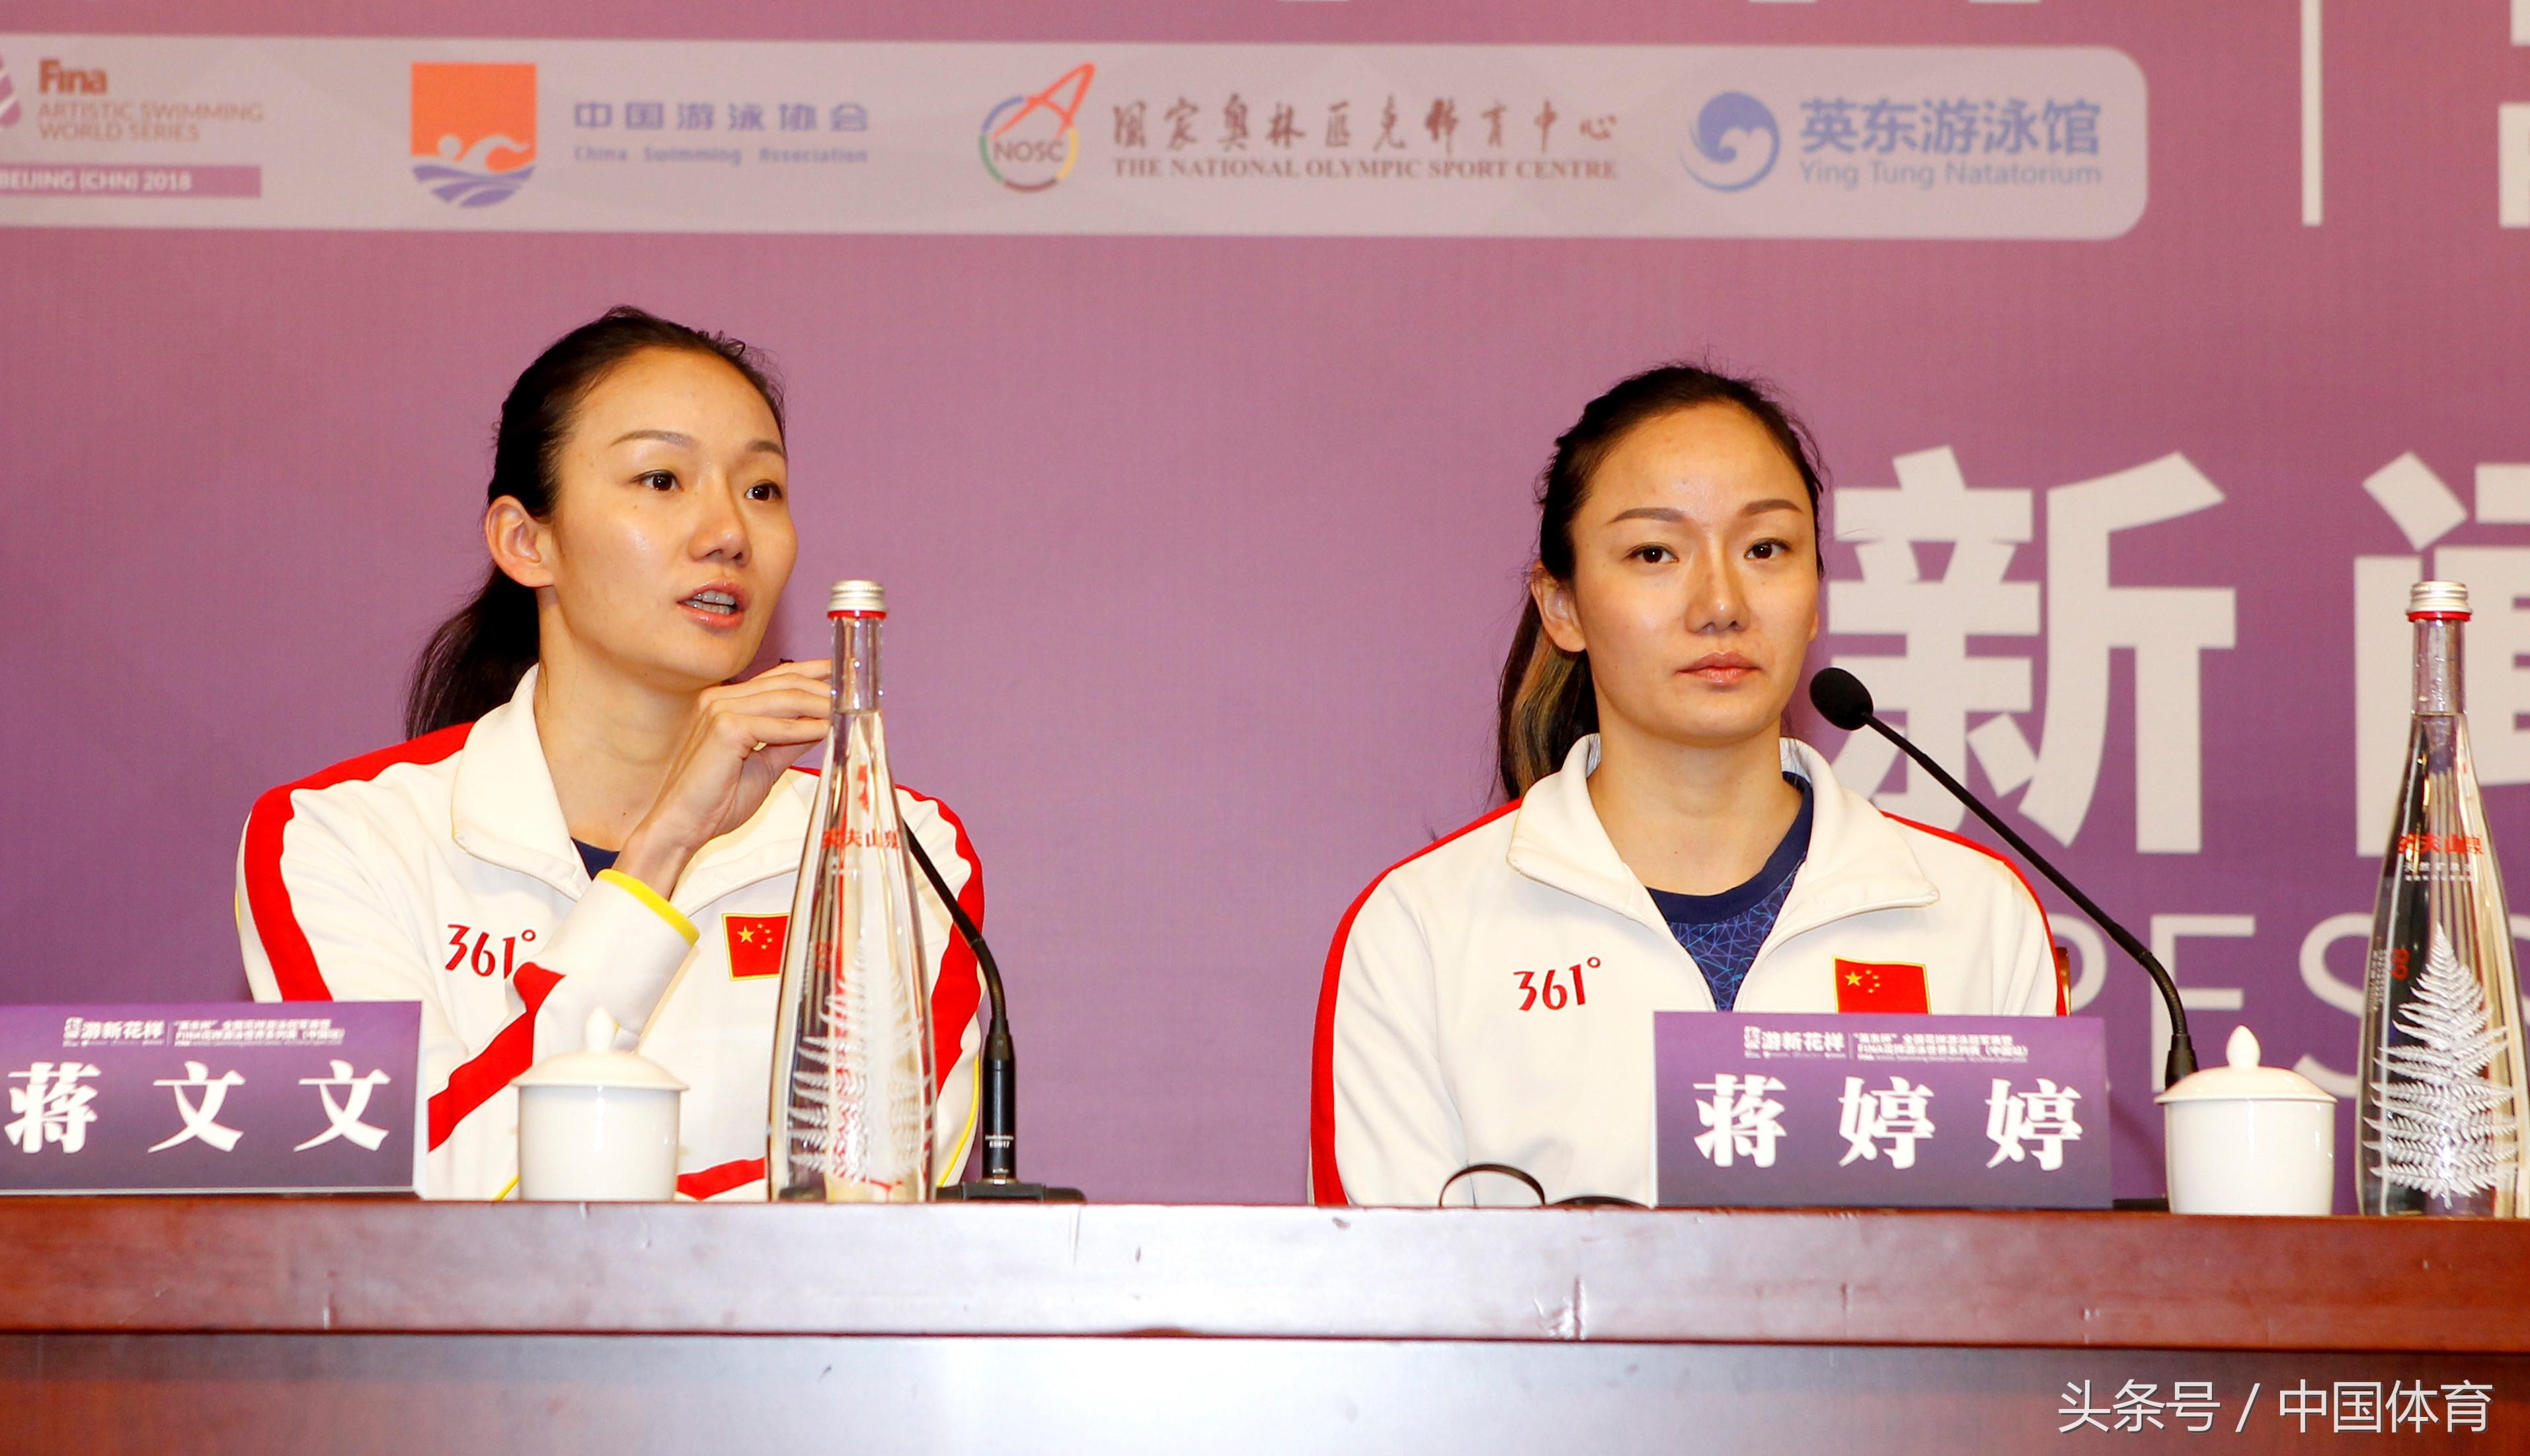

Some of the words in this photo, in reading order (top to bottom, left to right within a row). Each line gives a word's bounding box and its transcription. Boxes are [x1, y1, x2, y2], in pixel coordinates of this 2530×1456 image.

[40, 59, 108, 94] Fina
[39, 102, 132, 120] ARTISTIC
[141, 102, 264, 122] SWIMMING
[574, 102, 868, 132] 中国游泳协会
[40, 123, 123, 141] WORLD
[129, 124, 199, 141] SERIES
[1799, 98, 2101, 156] 英东游泳馆
[574, 145, 627, 163] China
[644, 146, 742, 167] Swimming
[759, 147, 868, 164] Association
[994, 141, 1064, 163] NOSC
[0, 169, 75, 190] BEIJING
[80, 171, 139, 192] (CHN)
[143, 171, 192, 191] 2018
[1113, 157, 1160, 177] THE
[1169, 158, 1300, 178] NATIONAL
[1305, 159, 1422, 178] OLYMPIC
[1428, 160, 1508, 179] SPORT
[1516, 160, 1616, 180] CENTRE
[1799, 161, 1859, 188] Ying
[1872, 162, 1935, 190] Tung
[1945, 163, 2102, 185] Natatorium
[4, 1060, 391, 1154] 蒋文文
[1693, 1073, 2083, 1170] 蒋婷婷
